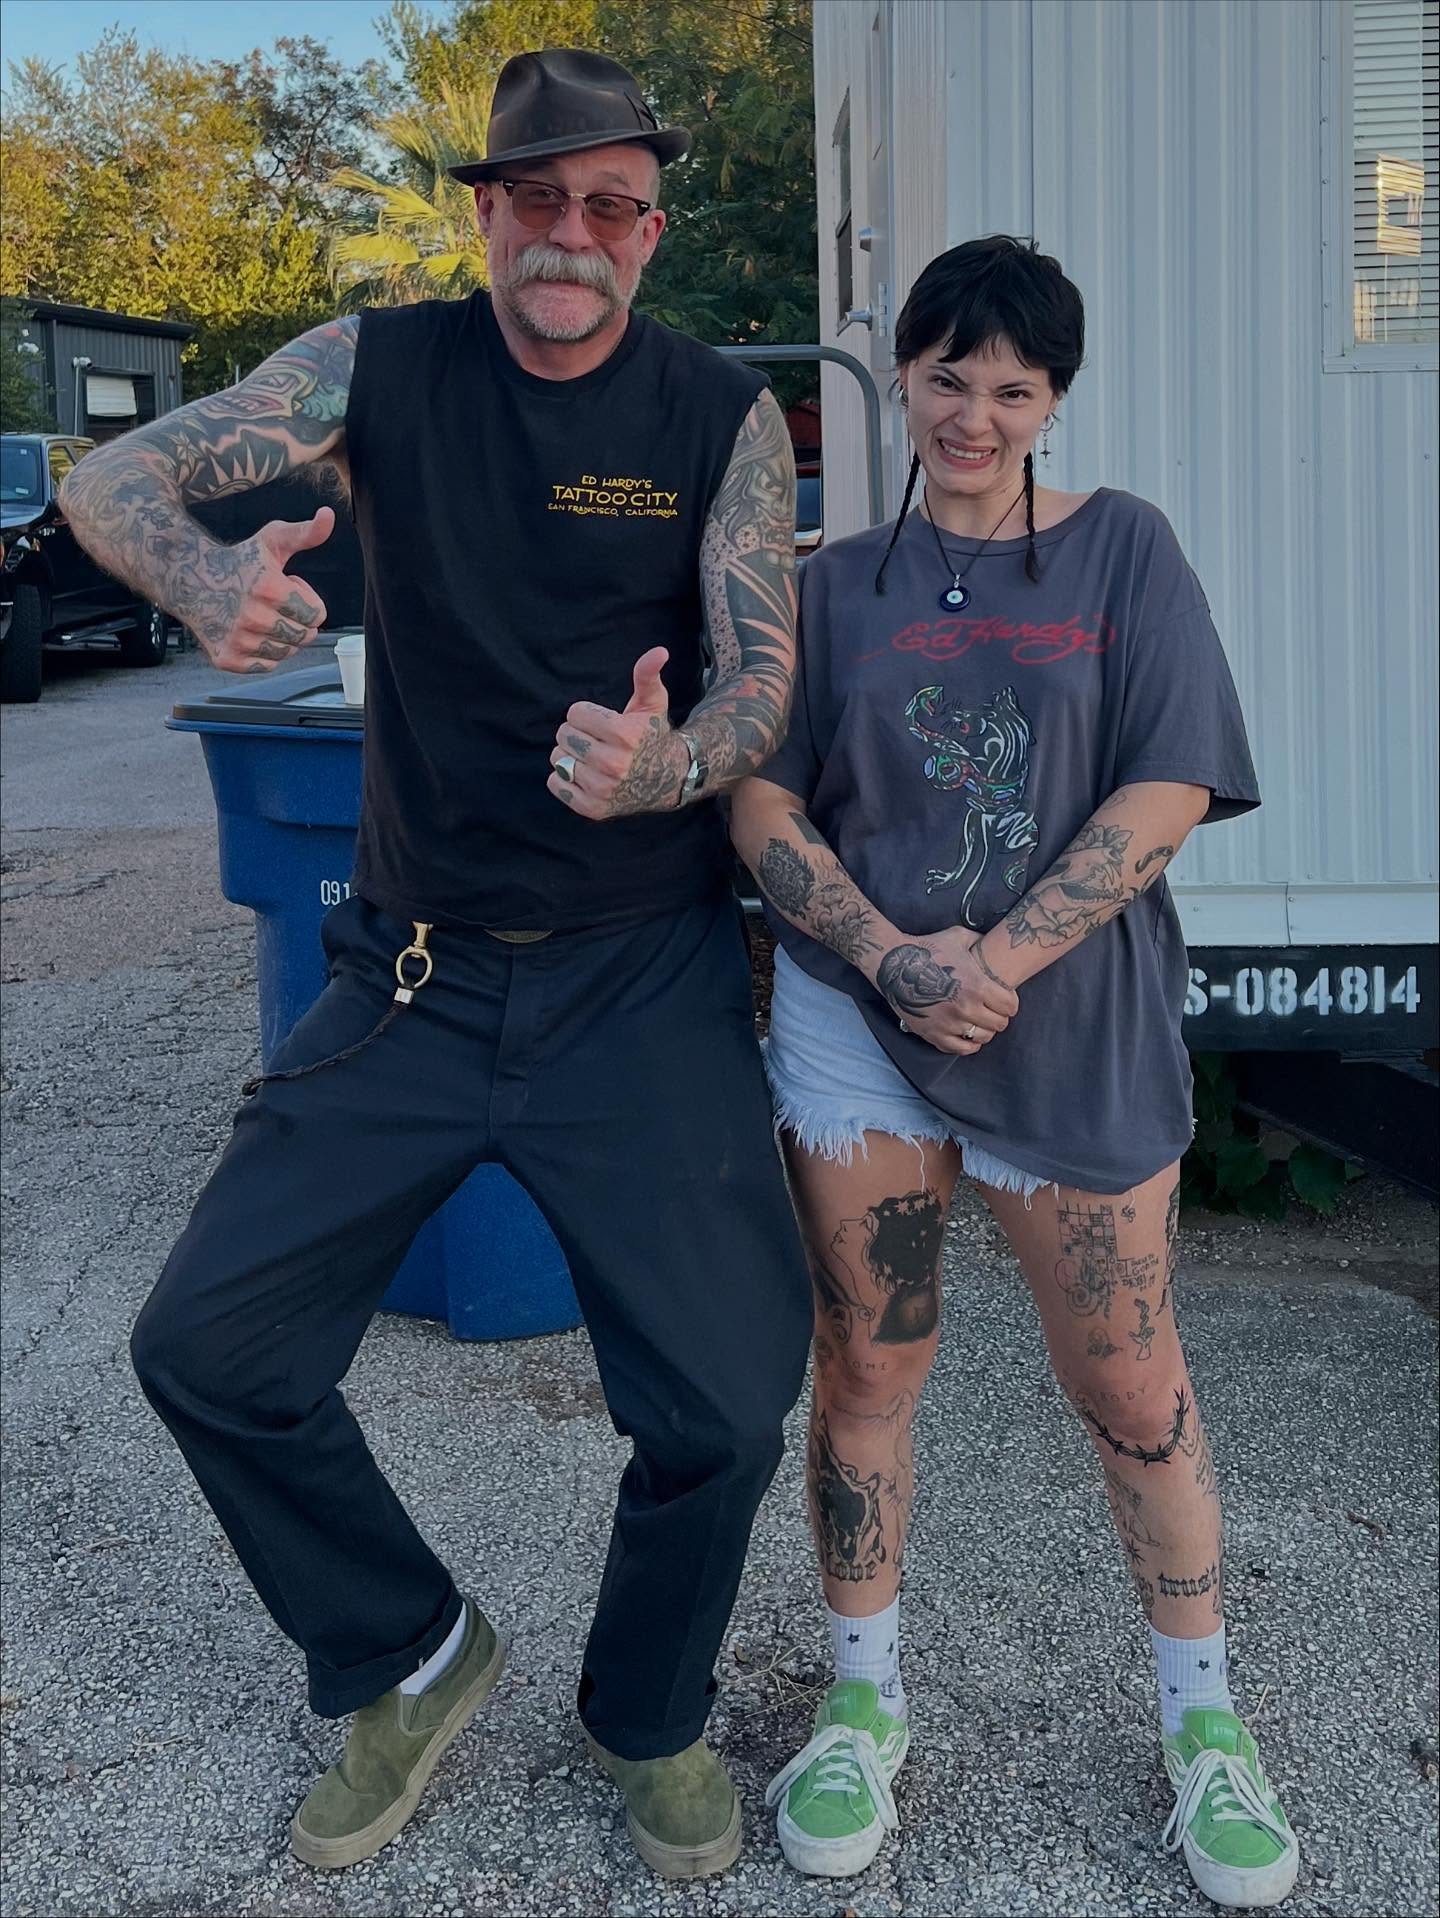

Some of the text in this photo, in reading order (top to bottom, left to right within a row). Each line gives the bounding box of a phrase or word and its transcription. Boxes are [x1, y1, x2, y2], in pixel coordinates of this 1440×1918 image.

[581, 475, 653, 491] ED HARDY'S
[552, 485, 678, 506] TATTOO CITY
[547, 503, 679, 518] SAN FRANCISCO, CALIFORNIA
